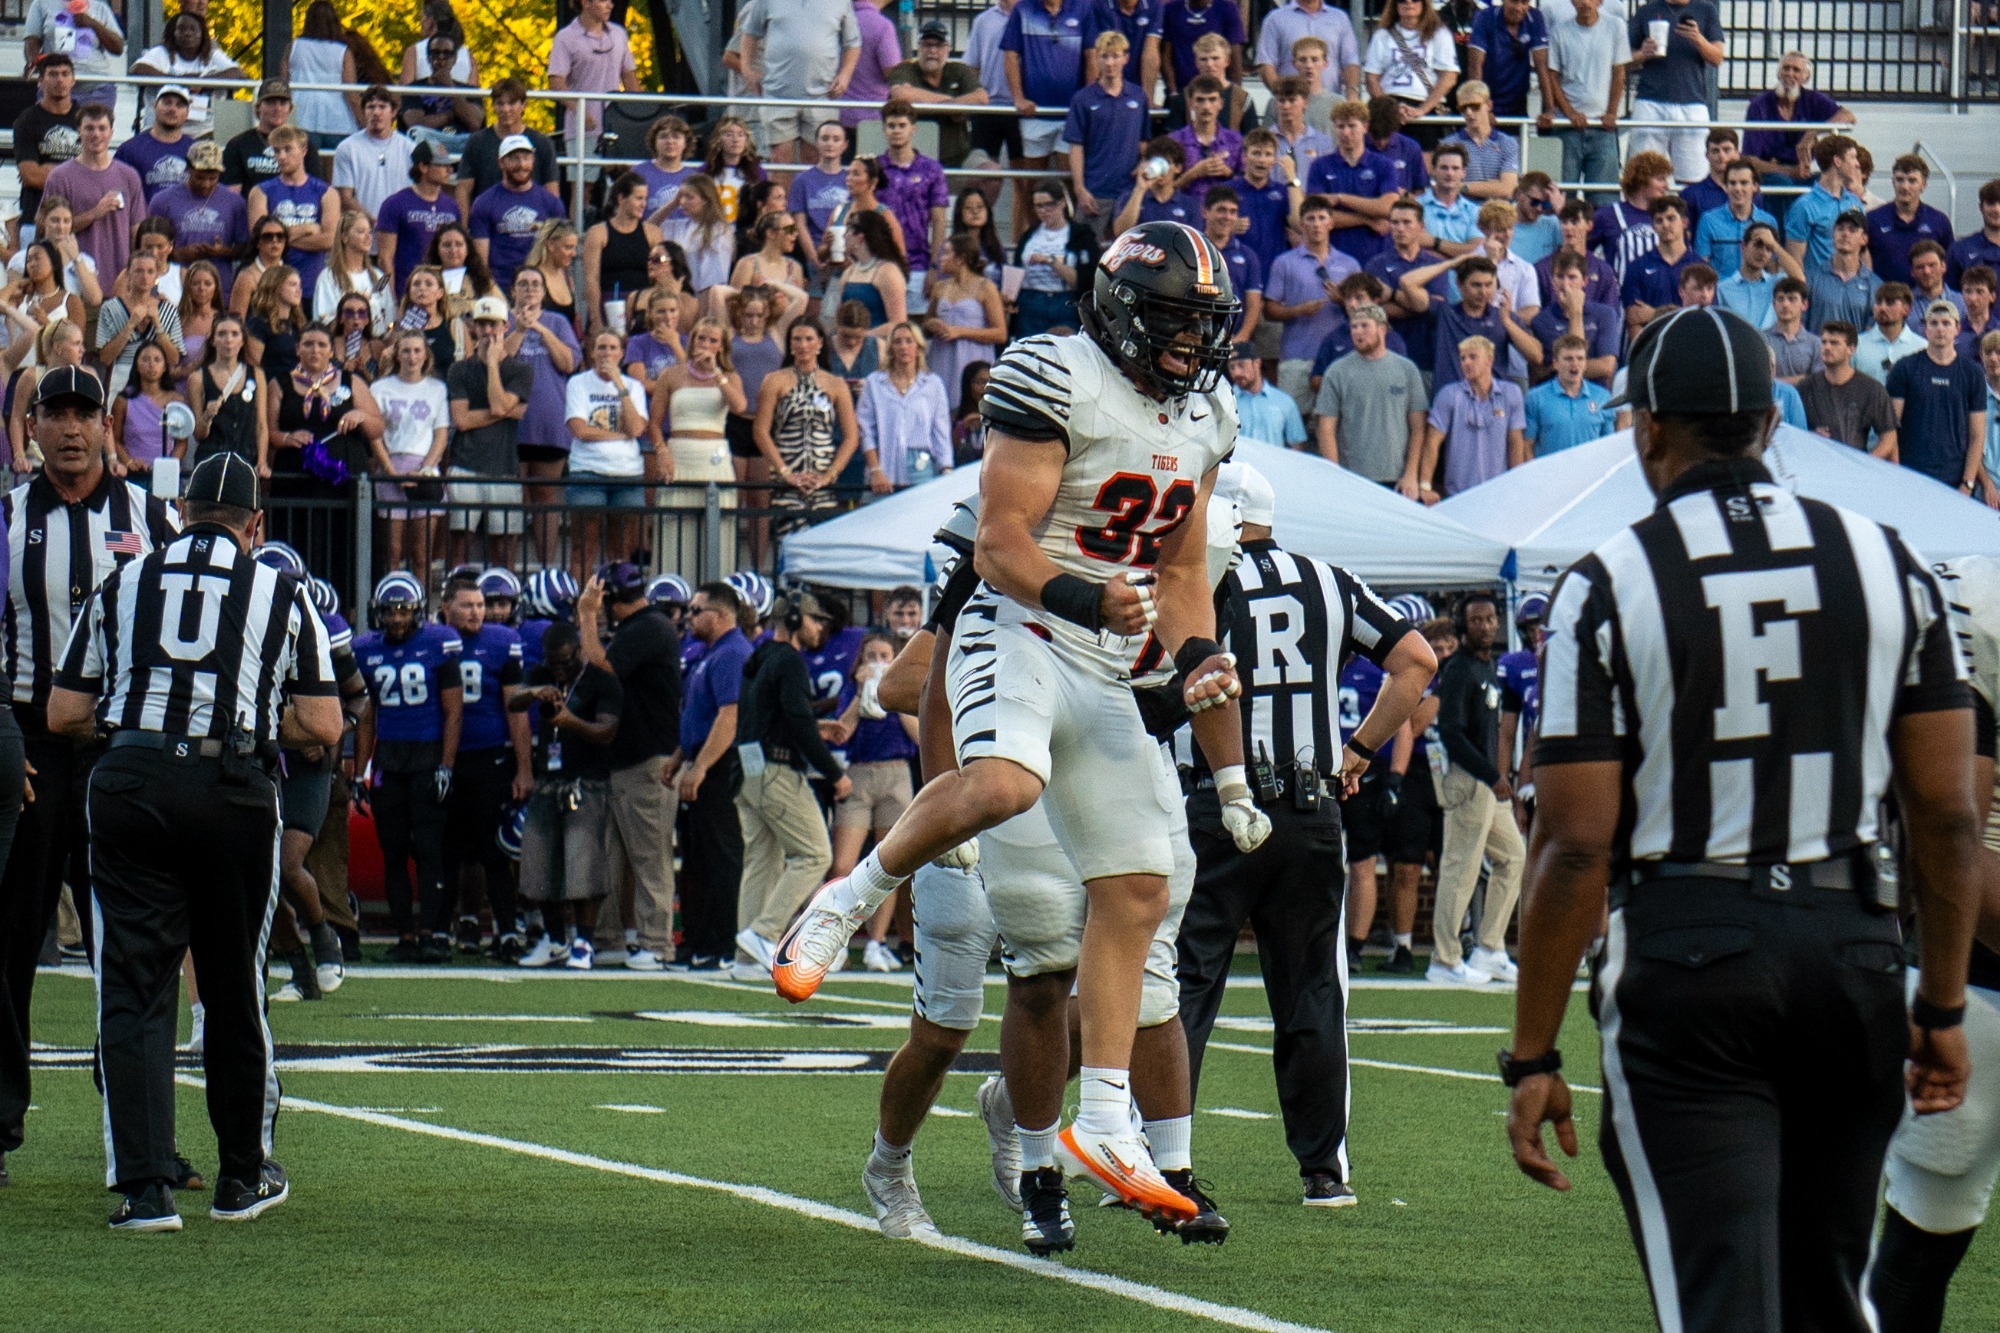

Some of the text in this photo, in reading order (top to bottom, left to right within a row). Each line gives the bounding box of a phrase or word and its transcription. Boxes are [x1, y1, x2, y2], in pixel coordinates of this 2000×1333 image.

[1099, 231, 1166, 273] Tigers
[1151, 454, 1179, 472] TIGERS
[1075, 471, 1196, 570] 32
[160, 572, 232, 662] U
[1248, 593, 1313, 686] R
[1701, 565, 1821, 741] F
[374, 662, 428, 707] 28
